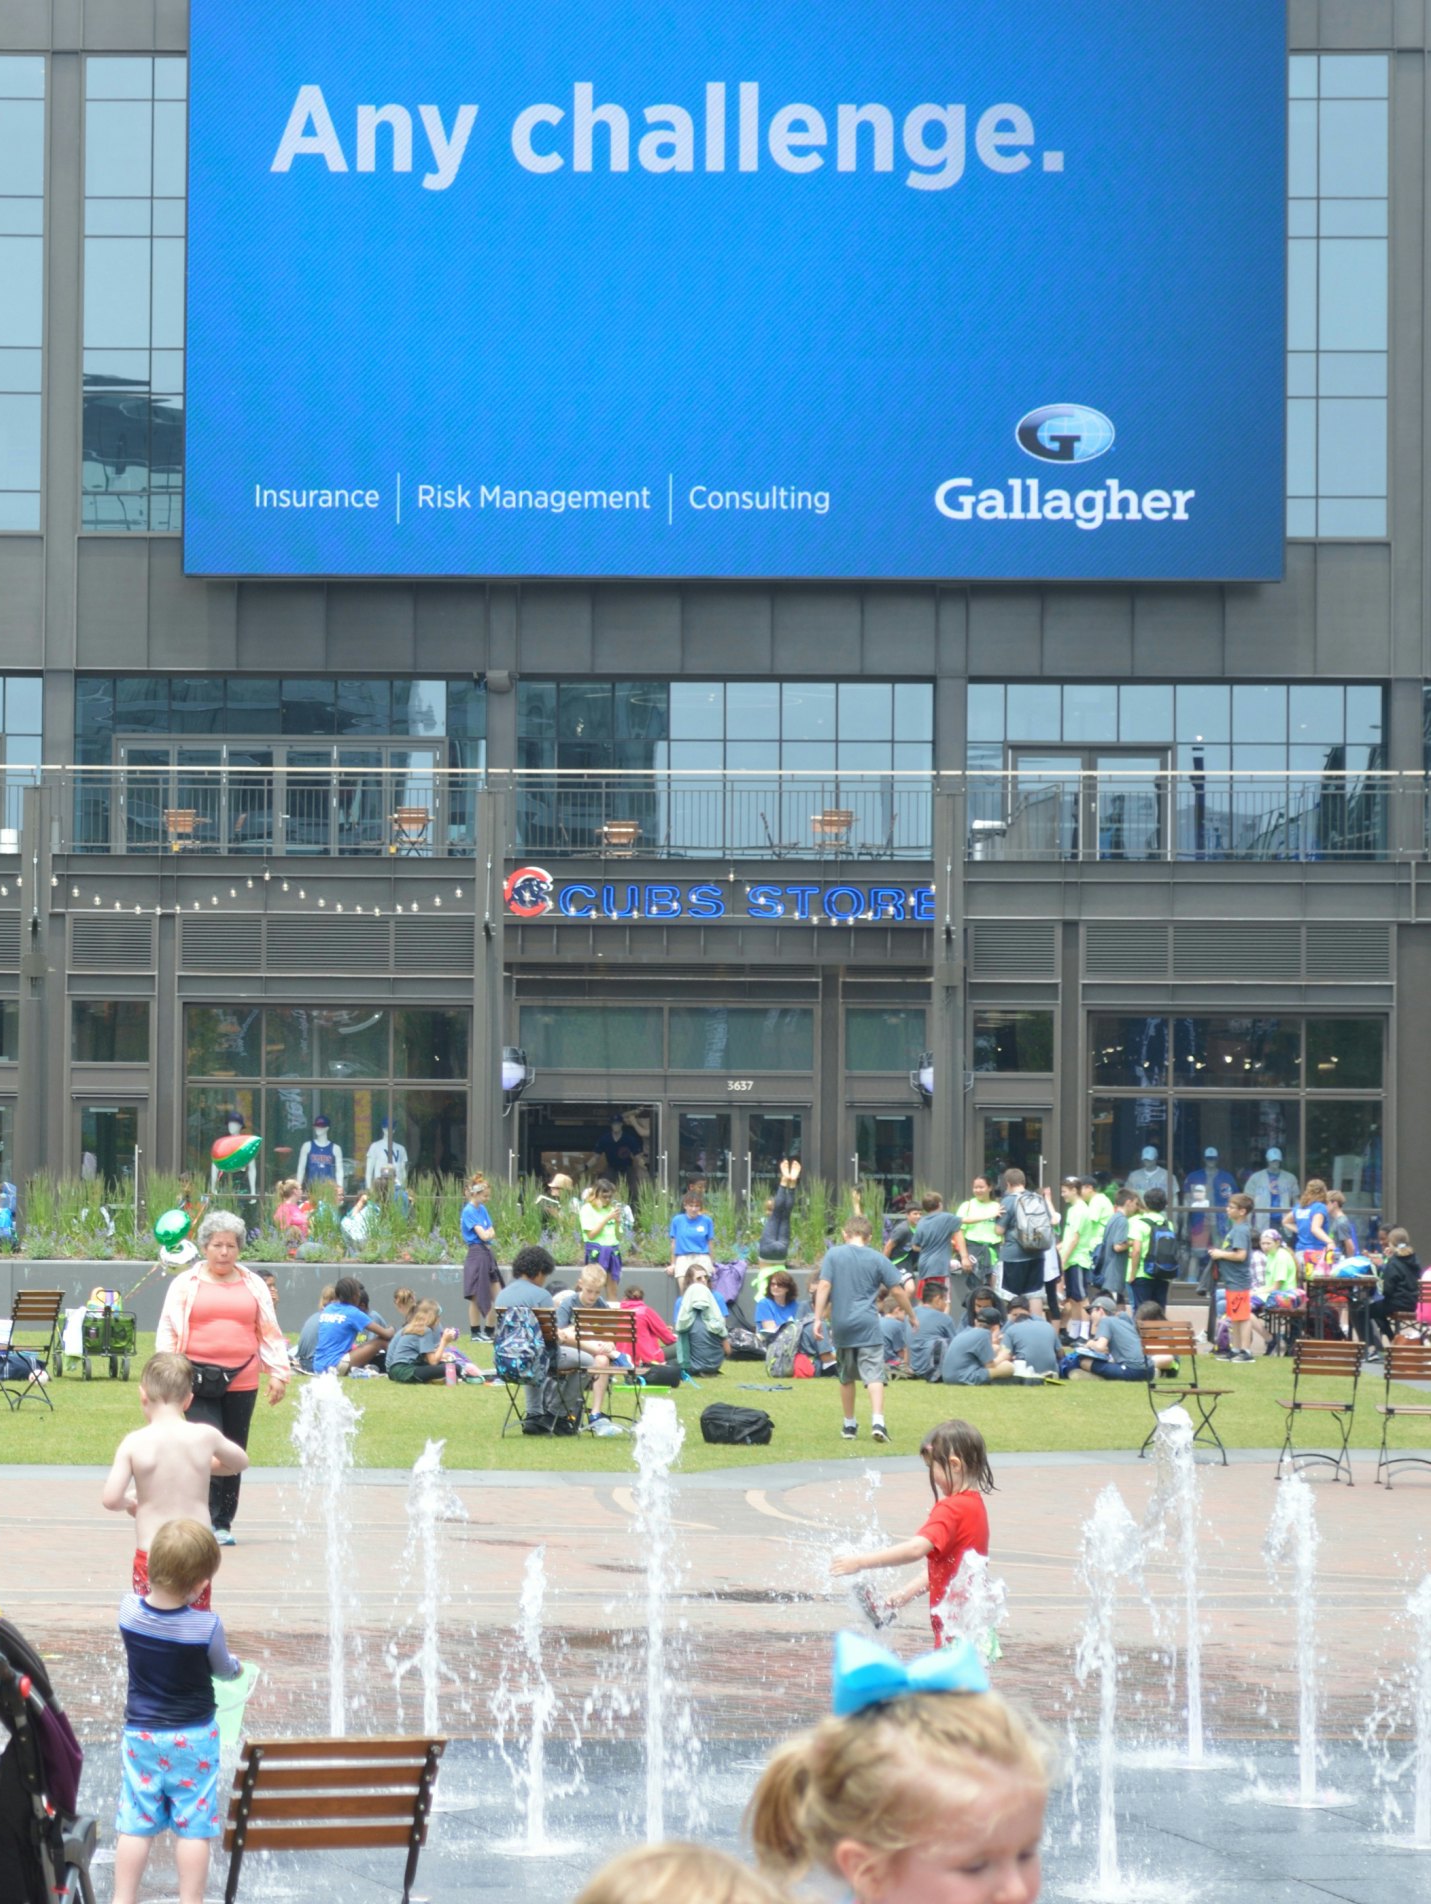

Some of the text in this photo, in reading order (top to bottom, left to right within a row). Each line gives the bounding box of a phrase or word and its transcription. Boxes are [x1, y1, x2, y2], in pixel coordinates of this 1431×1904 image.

[270, 81, 1066, 192] Any challenge.
[253, 483, 831, 518] Insurance Risk Management Consulting
[934, 476, 1196, 530] Gallagher
[558, 883, 935, 921] CUBS STORE
[727, 1080, 754, 1091] 3637
[319, 1313, 347, 1324] STAFF
